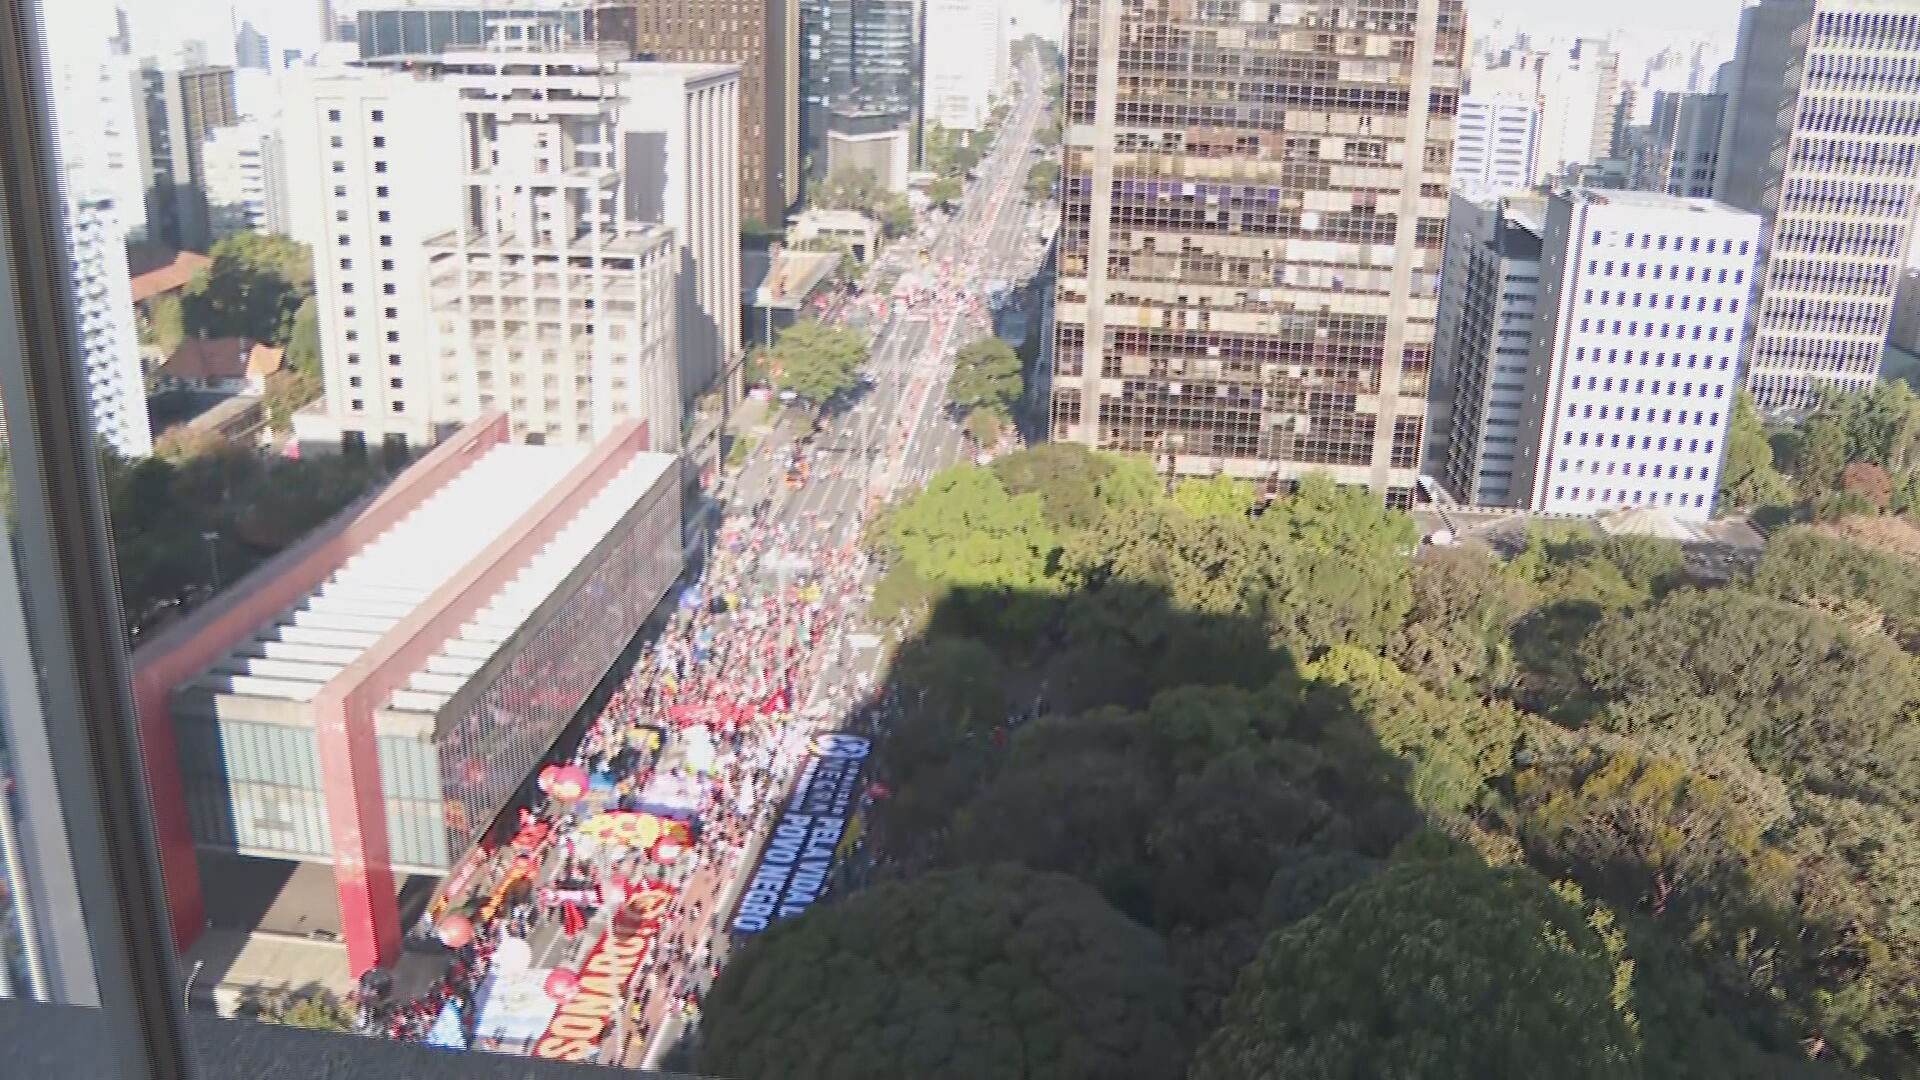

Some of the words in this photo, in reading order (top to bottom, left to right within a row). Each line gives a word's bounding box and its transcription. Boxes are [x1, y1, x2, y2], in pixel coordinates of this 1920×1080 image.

[764, 814, 813, 863] POVO
[800, 816, 845, 858] PELA
[733, 865, 793, 932] NEGRO
[783, 861, 830, 904] VIDA
